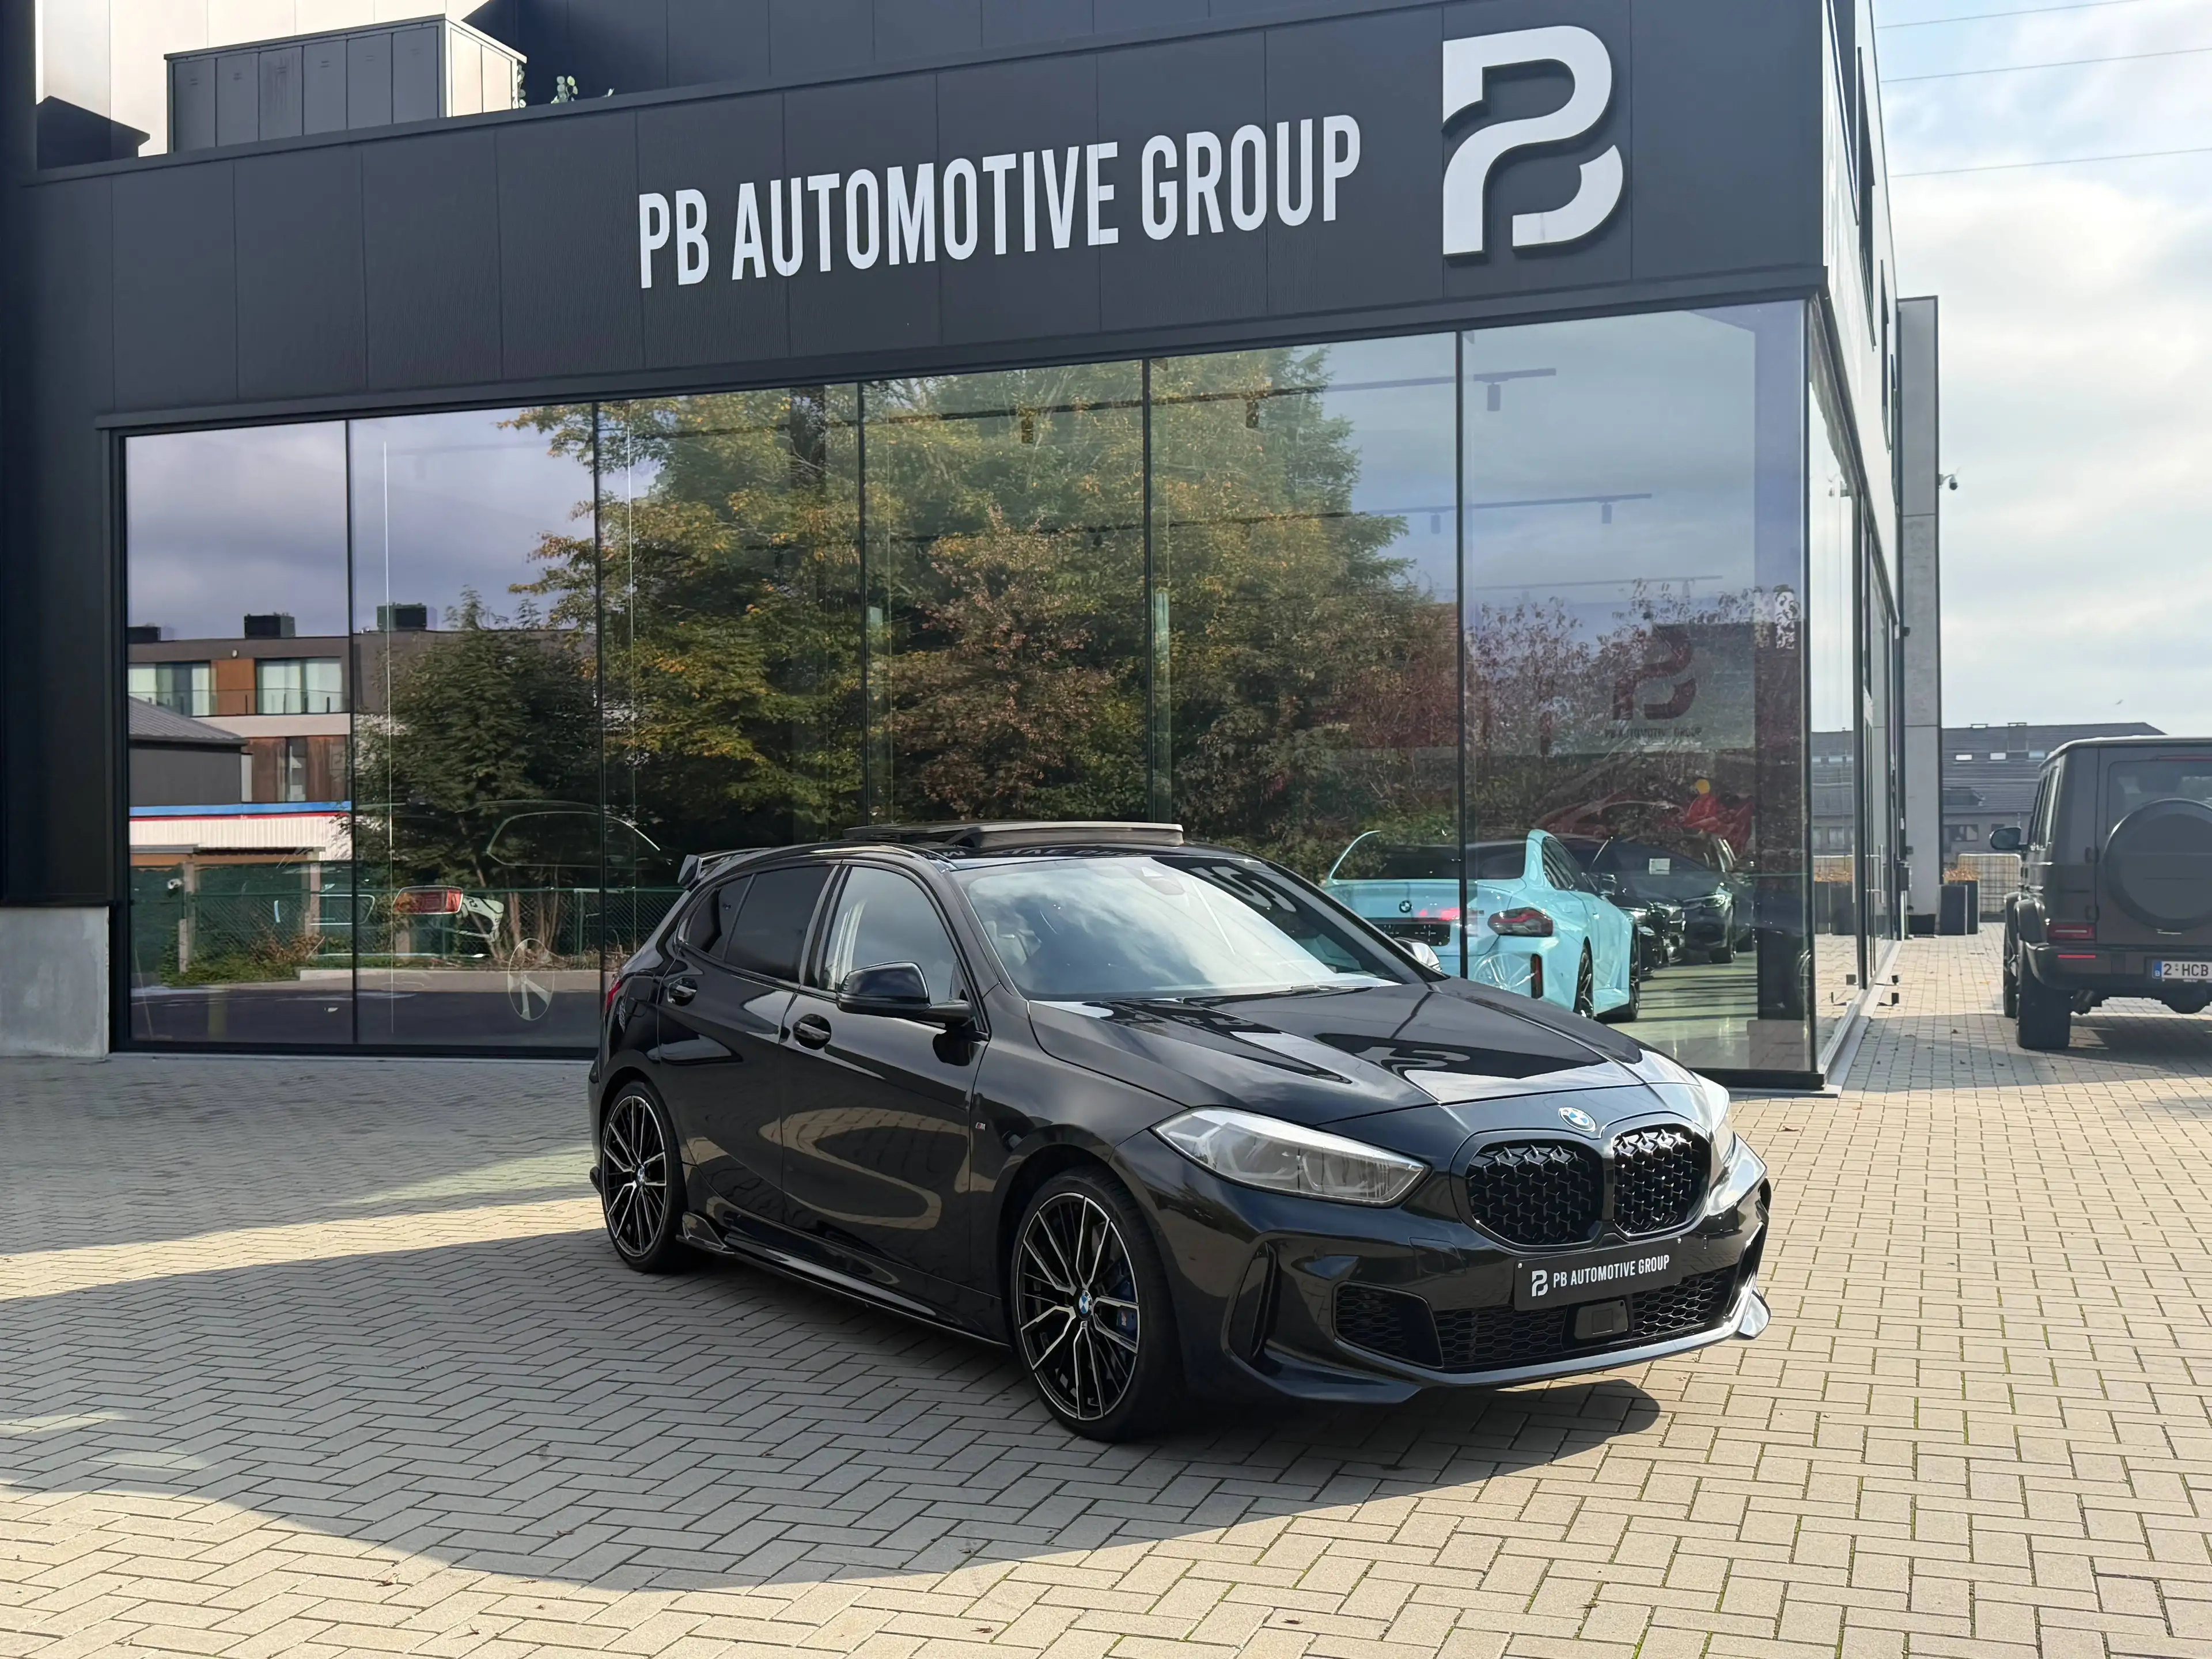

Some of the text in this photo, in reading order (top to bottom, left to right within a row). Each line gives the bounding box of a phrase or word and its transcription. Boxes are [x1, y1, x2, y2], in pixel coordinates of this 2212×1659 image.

[639, 115, 1359, 288] PB AUTOMOTIVE GROUP
[1553, 1255, 1670, 1288] PB AUTOMOTIVE GROUP
